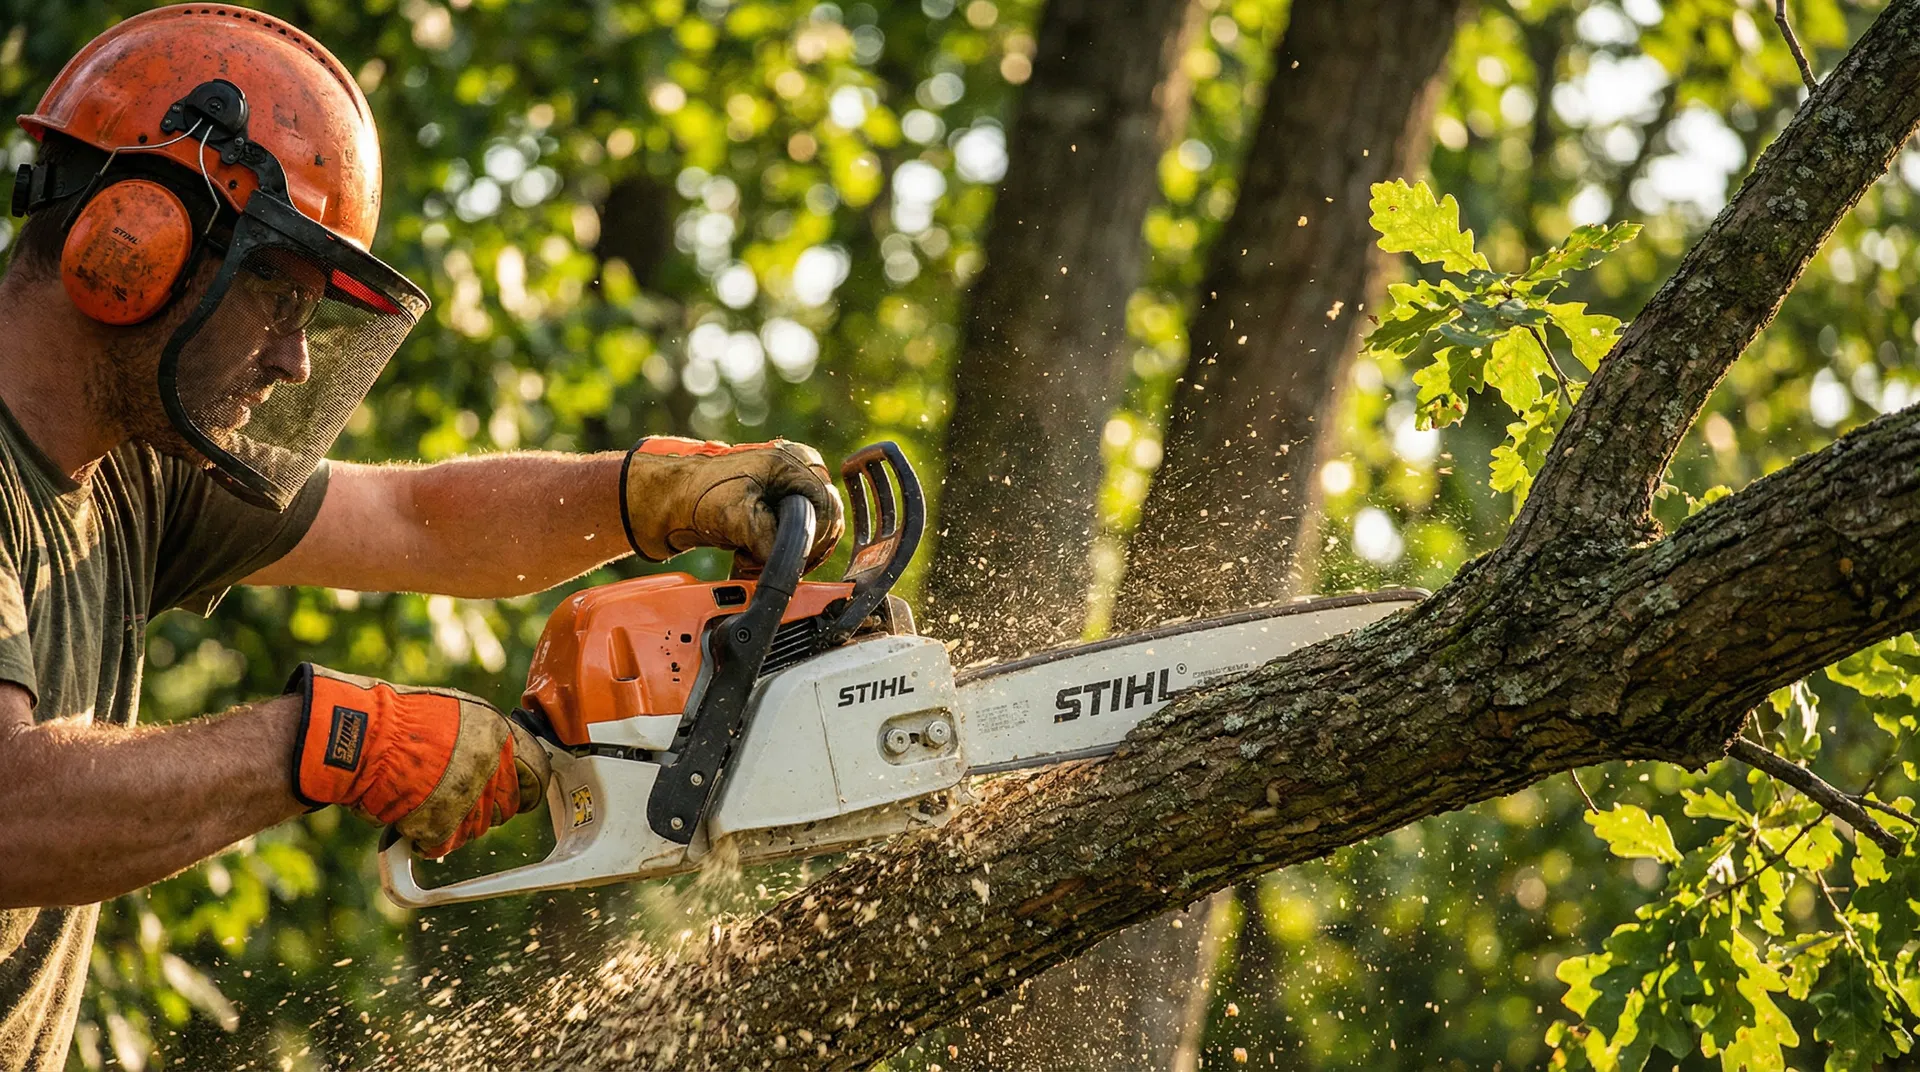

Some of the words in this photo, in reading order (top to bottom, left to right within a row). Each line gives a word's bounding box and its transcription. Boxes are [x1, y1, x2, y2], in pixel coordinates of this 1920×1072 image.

[112, 226, 138, 245] STIHL
[837, 675, 915, 707] STIHL
[1053, 668, 1180, 723] STIHL
